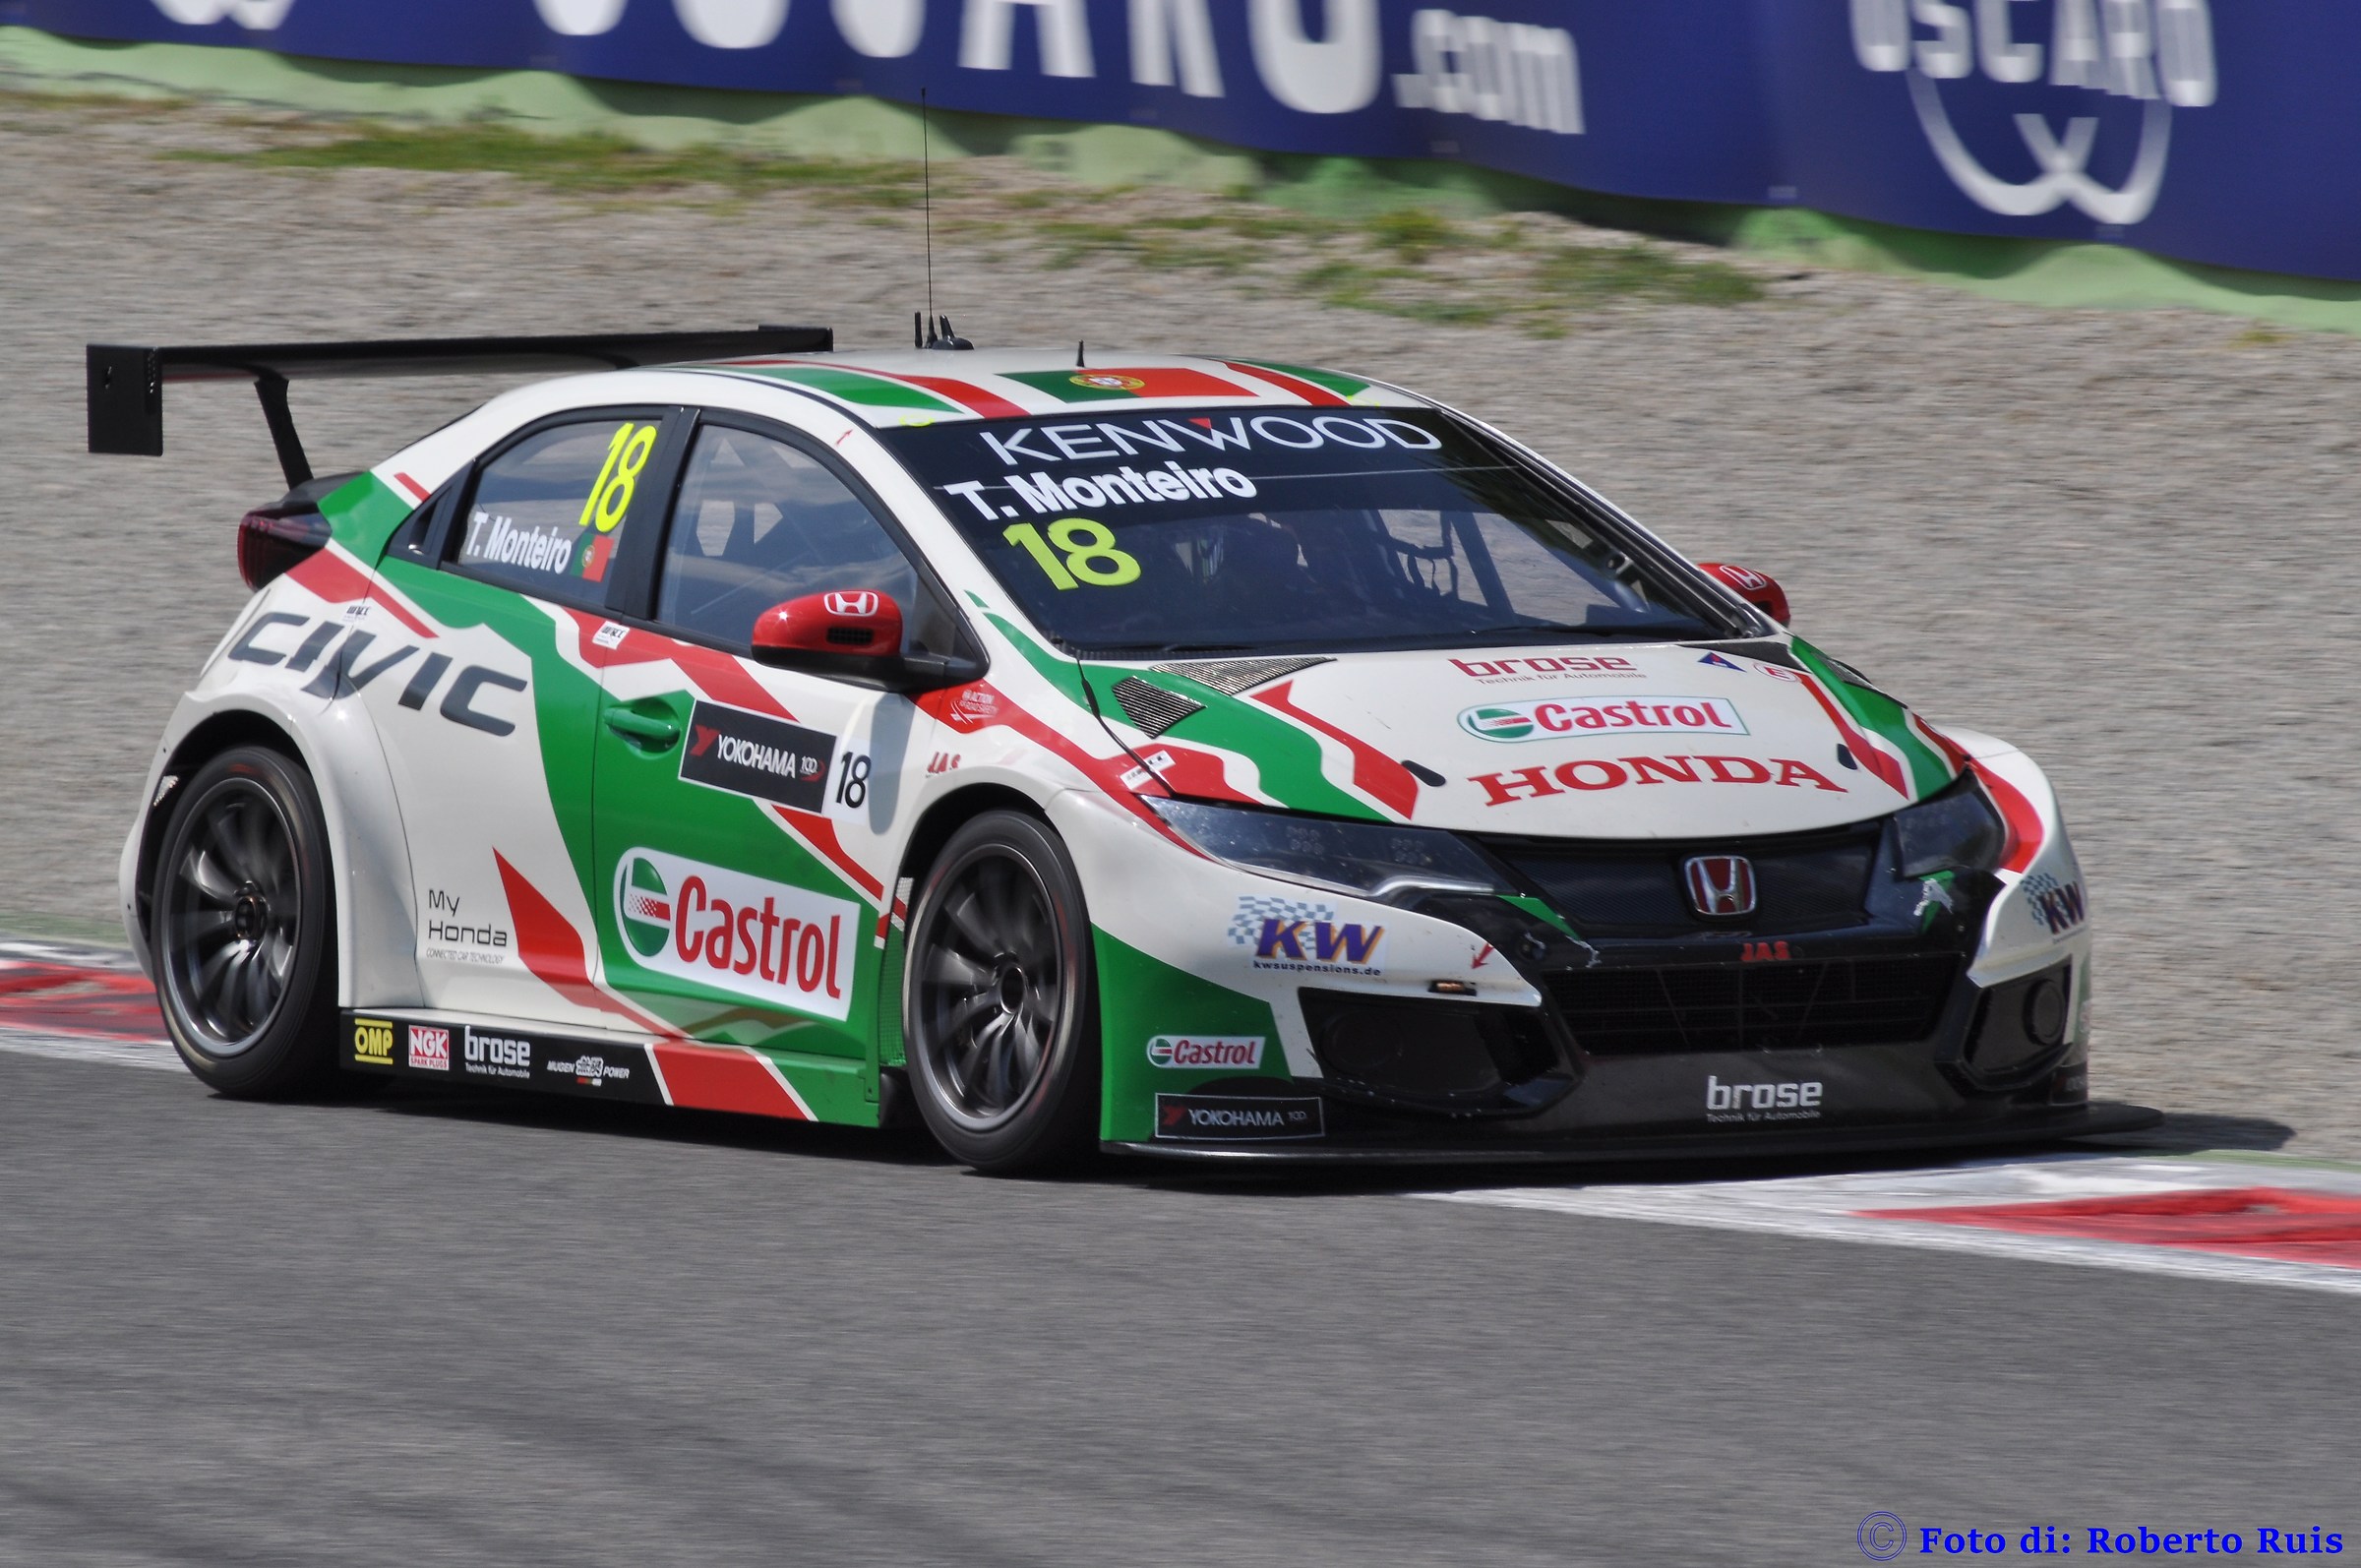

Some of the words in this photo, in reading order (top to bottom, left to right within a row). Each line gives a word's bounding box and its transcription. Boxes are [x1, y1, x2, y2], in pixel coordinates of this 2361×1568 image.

[979, 416, 1442, 465] KENWOOD
[578, 422, 657, 532] 18
[1003, 460, 1257, 514] Monteiro
[466, 512, 488, 556] T.
[486, 515, 573, 574] Monteiro
[1002, 517, 1141, 590] 18
[227, 611, 528, 738] CIVIC
[1448, 656, 1639, 678] brose
[1476, 675, 1536, 686] Technik
[1562, 672, 1648, 681] Automobile
[1534, 699, 1732, 733] Castrol
[716, 735, 796, 779] YOKOHAMA
[835, 751, 872, 809] 18
[1467, 755, 1848, 807] HONDA
[429, 888, 459, 917] My
[428, 919, 508, 947] Honda
[676, 874, 841, 999] Castrol
[1255, 918, 1385, 964] KW
[1740, 940, 1789, 961] JAS
[1252, 960, 1382, 976] kwsuspensions.de
[355, 1026, 393, 1056] OMP
[410, 1030, 448, 1058] NGK
[464, 1025, 530, 1067] brose
[1174, 1039, 1256, 1064] Castrol
[410, 1056, 428, 1066] SPARK
[429, 1058, 448, 1068] PLUGS
[603, 1065, 630, 1079] POWER
[1707, 1075, 1823, 1111] brose
[1187, 1108, 1285, 1126] YOKOHAMA
